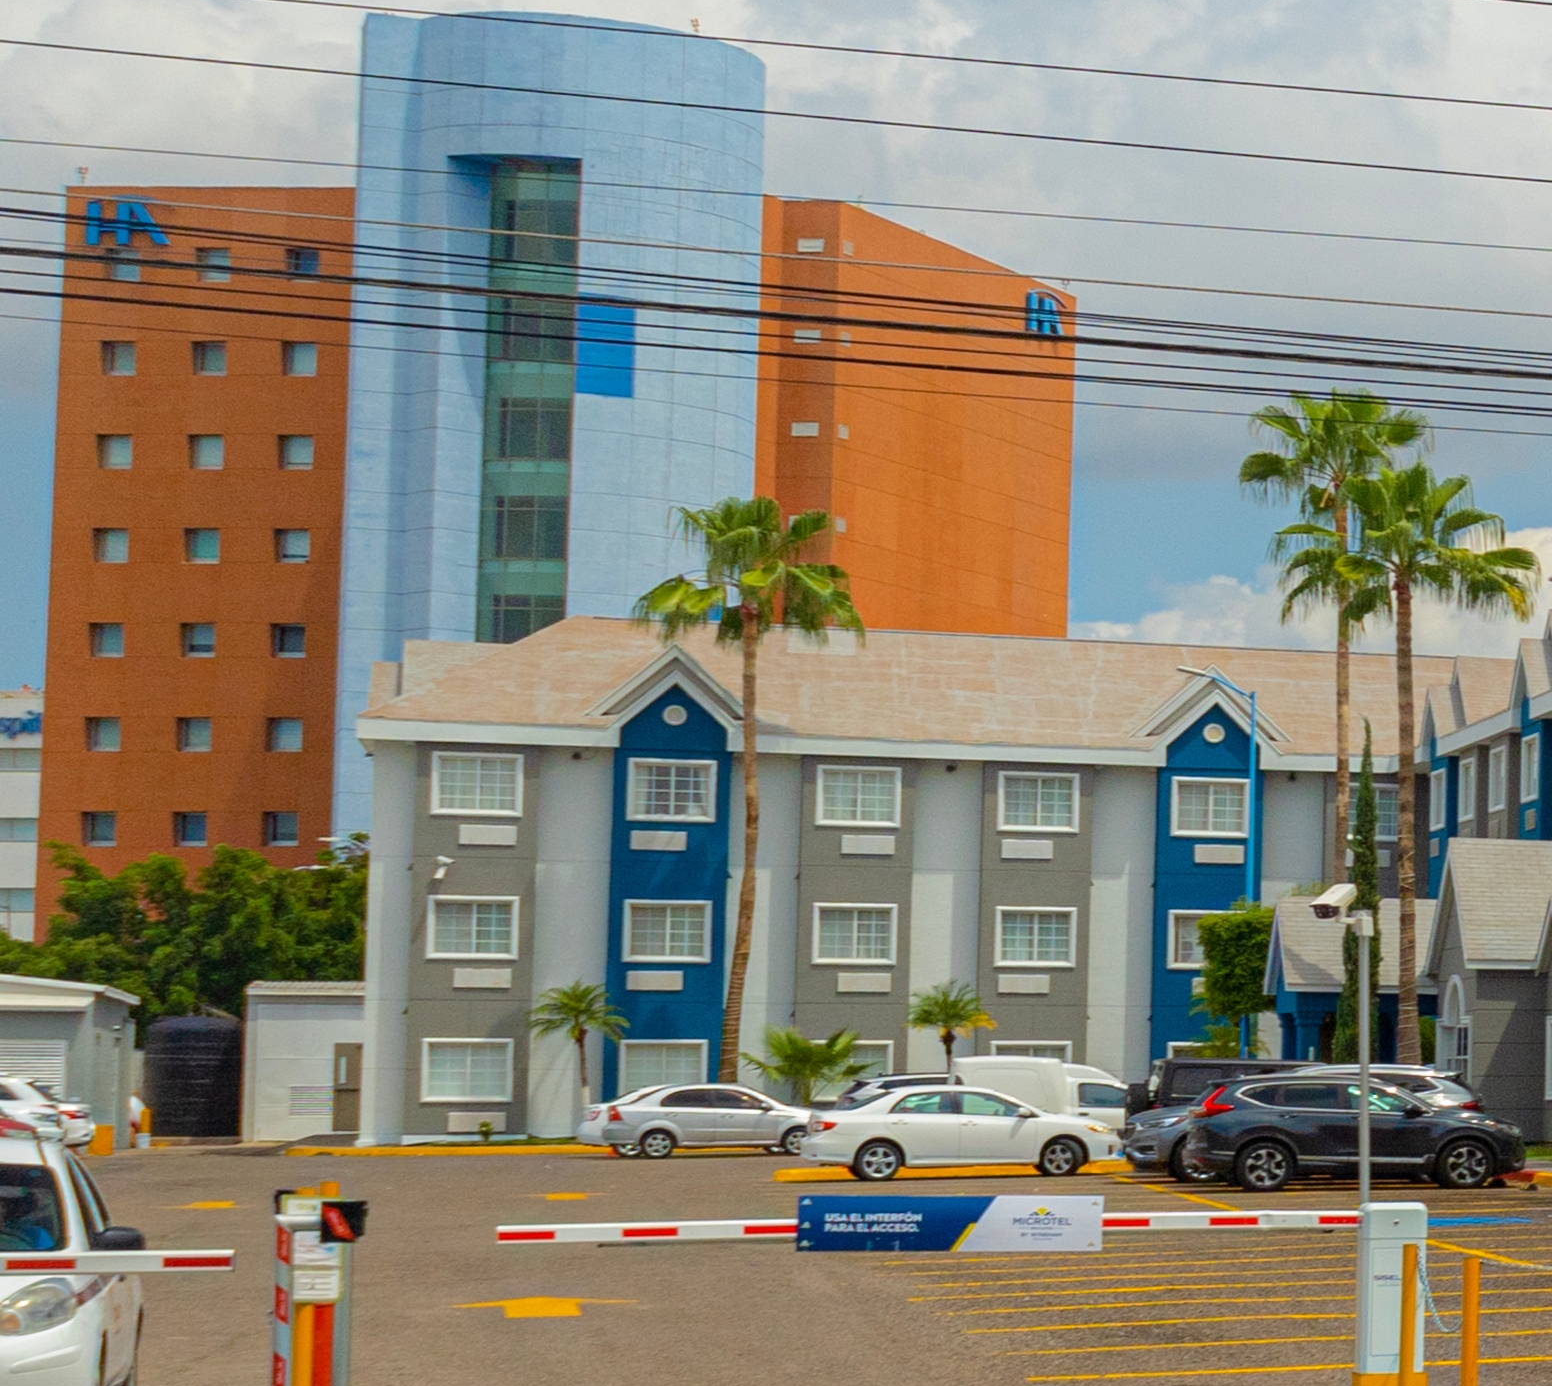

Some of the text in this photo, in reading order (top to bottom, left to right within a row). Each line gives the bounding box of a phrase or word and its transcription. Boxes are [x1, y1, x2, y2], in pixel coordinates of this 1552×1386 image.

[825, 1213, 847, 1222] USA
[849, 1213, 864, 1222] EL
[1012, 1217, 1072, 1225] MICROTEL
[825, 1223, 854, 1233] PARA
[856, 1223, 871, 1233] EL
